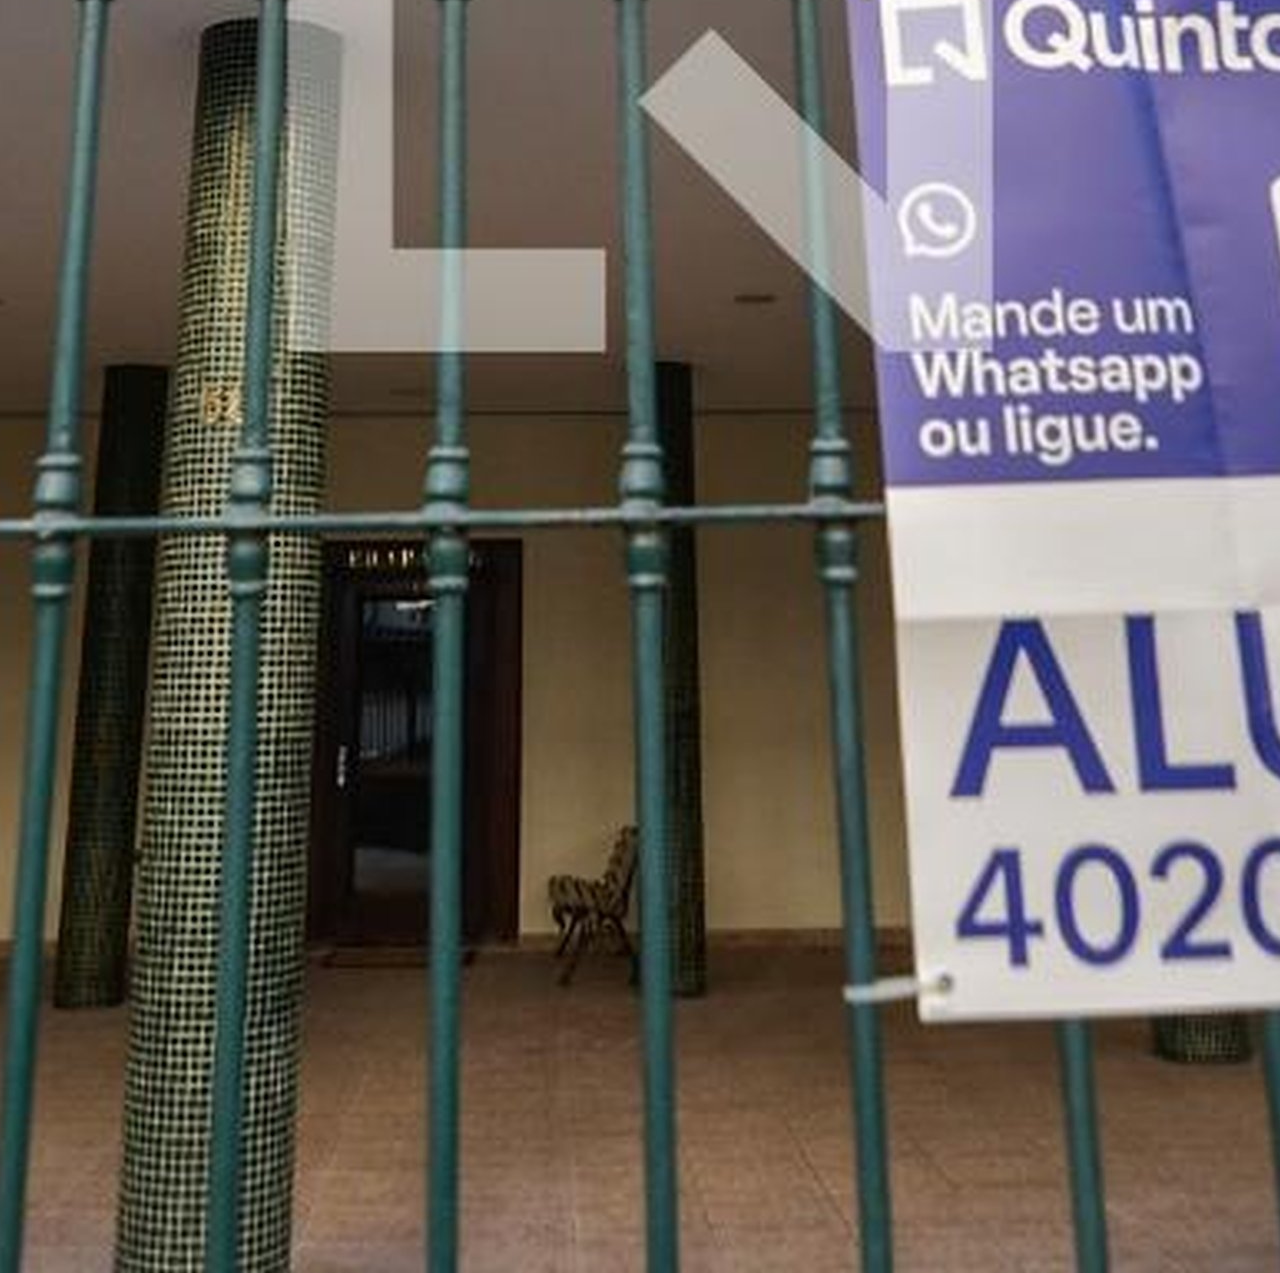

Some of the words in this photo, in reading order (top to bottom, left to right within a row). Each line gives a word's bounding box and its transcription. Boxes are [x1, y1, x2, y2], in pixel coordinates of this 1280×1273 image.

[909, 288, 1100, 341] Mande
[1113, 295, 1194, 334] um
[911, 347, 1203, 403] Whatsapp
[919, 417, 991, 458] ou
[1003, 403, 1160, 466] ligue.
